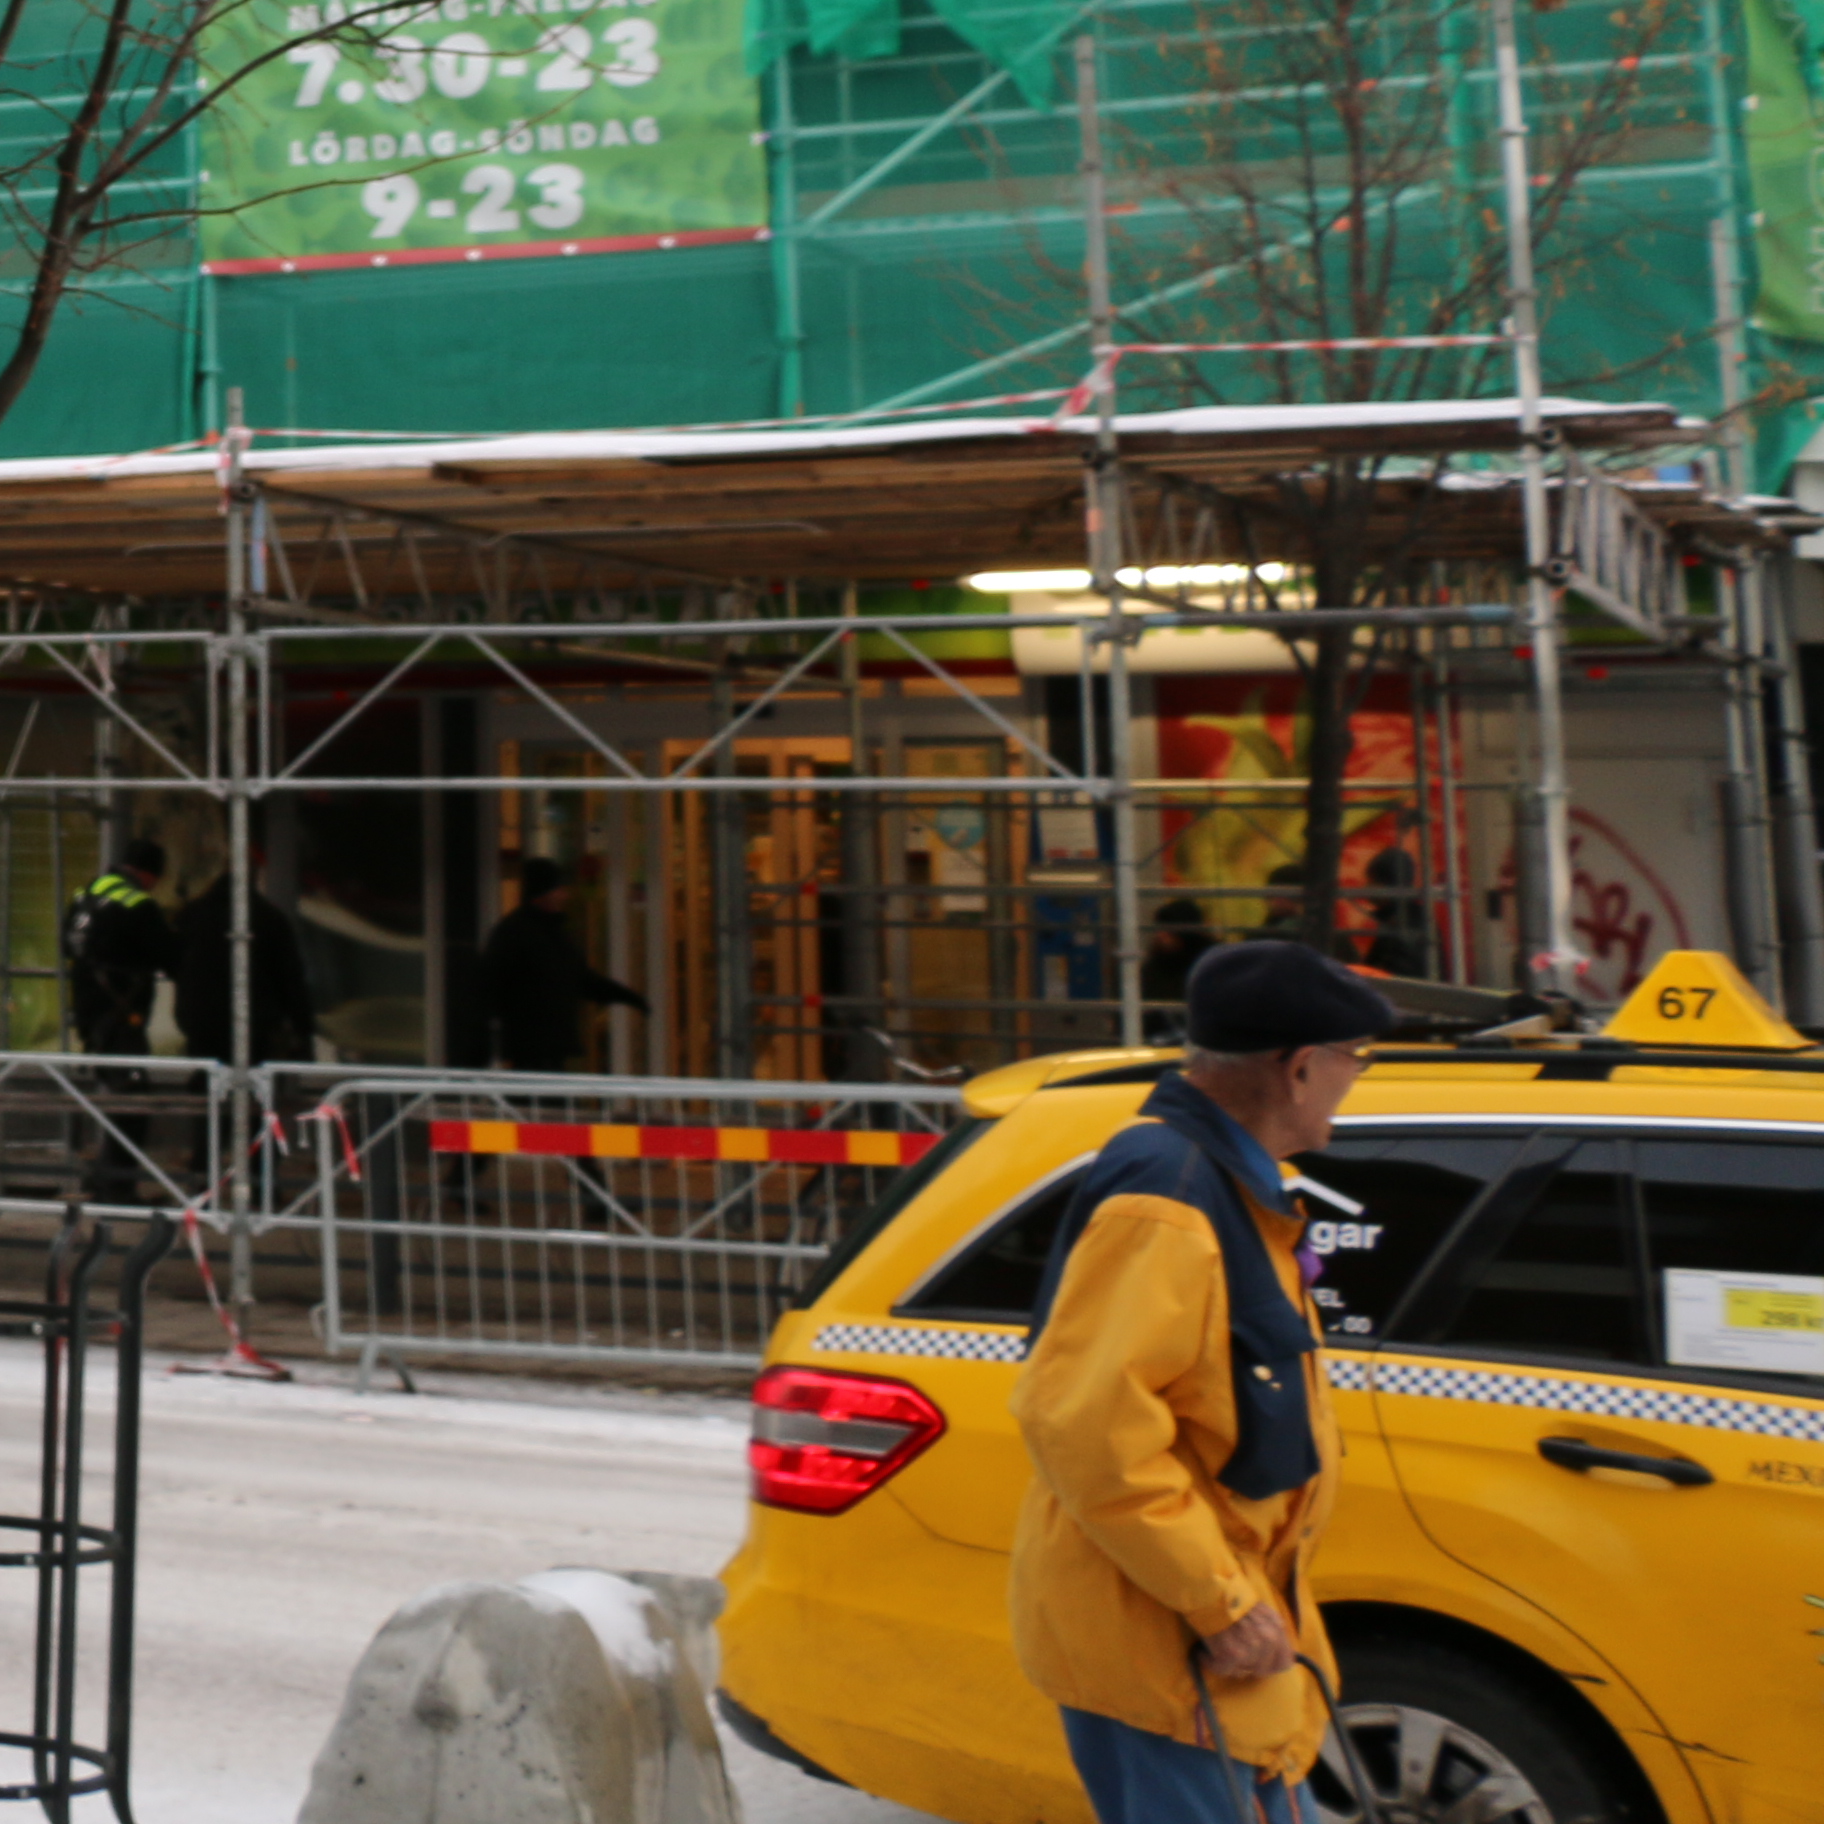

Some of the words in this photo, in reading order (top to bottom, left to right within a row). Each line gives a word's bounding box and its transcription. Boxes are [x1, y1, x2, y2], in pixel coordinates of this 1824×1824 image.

[288, 17, 659, 107] 7.30-23
[289, 116, 658, 166] LÖRDAG-SÖNDAG
[362, 162, 585, 239] 9-23
[1658, 986, 1716, 1020] 67
